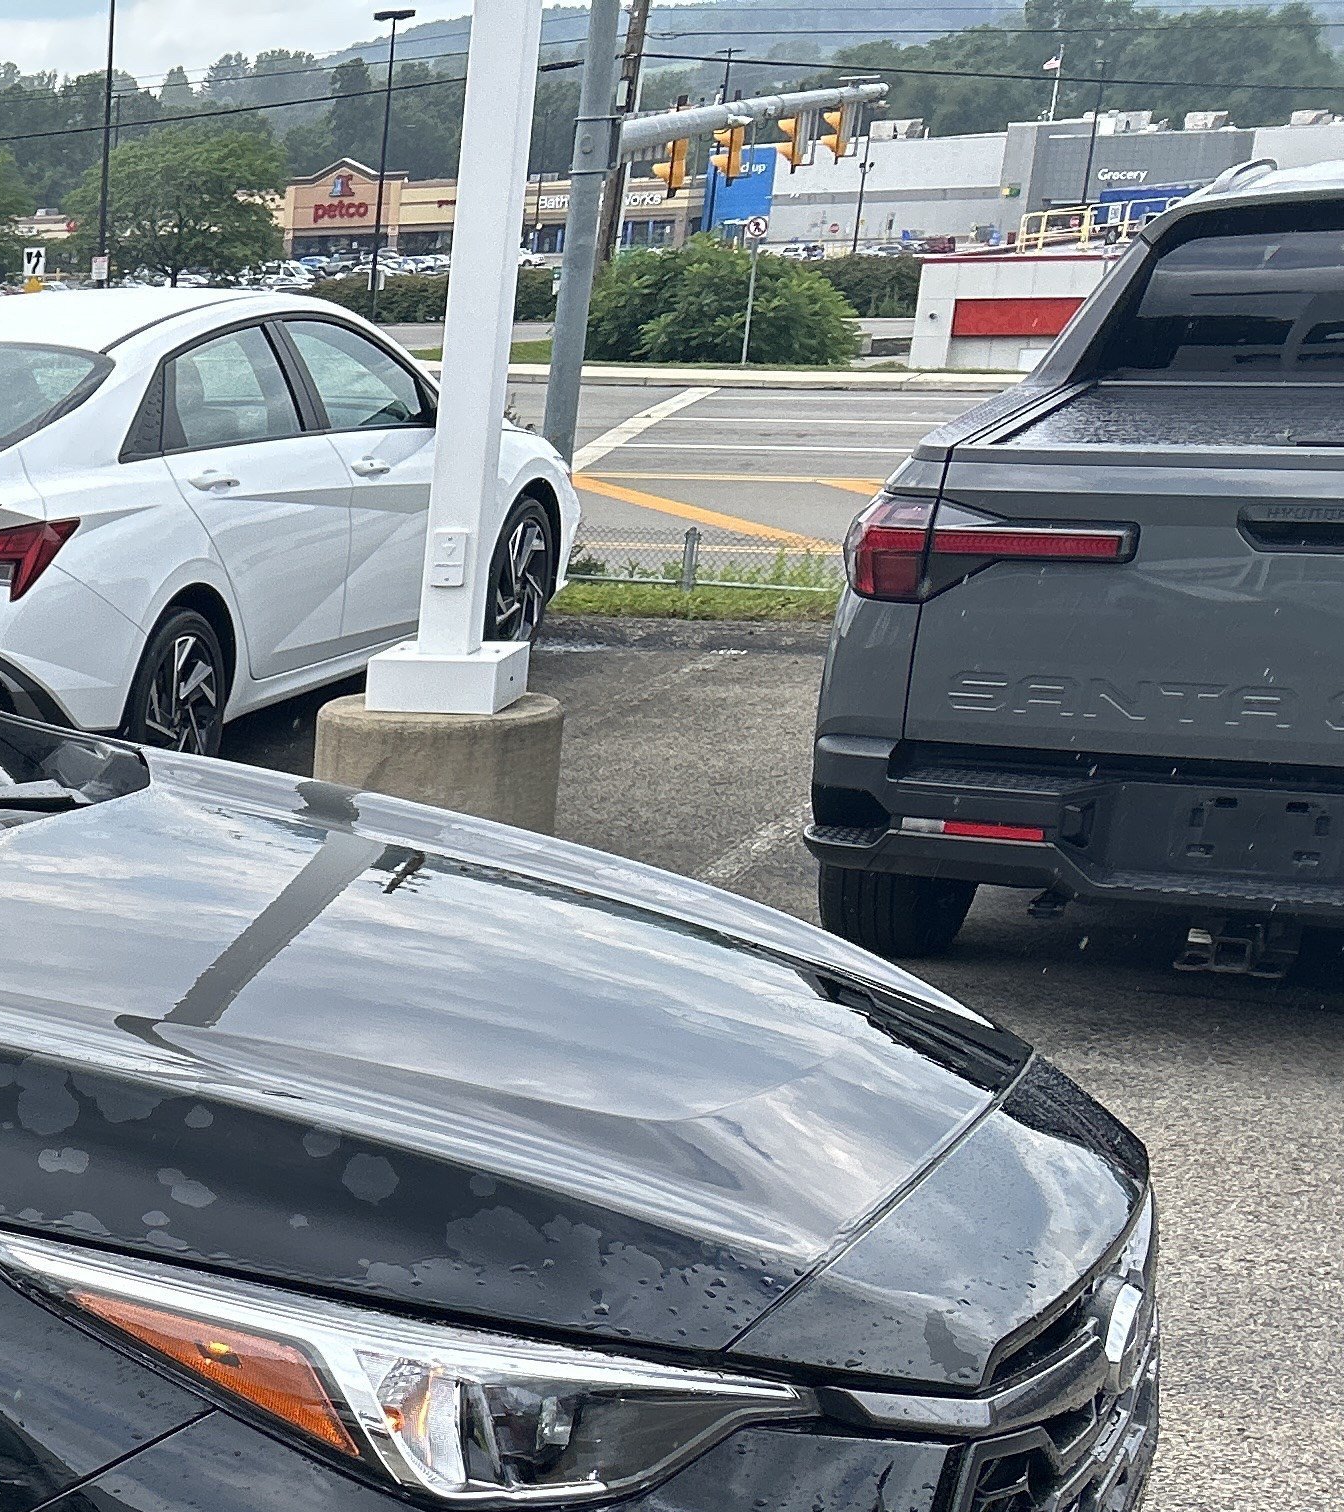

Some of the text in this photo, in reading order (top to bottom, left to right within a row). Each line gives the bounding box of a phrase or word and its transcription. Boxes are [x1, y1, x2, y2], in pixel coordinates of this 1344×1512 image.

[1097, 168, 1148, 183] Grocery
[538, 194, 570, 209] Bath
[313, 200, 369, 223] petco
[948, 670, 1300, 730] SANTA
